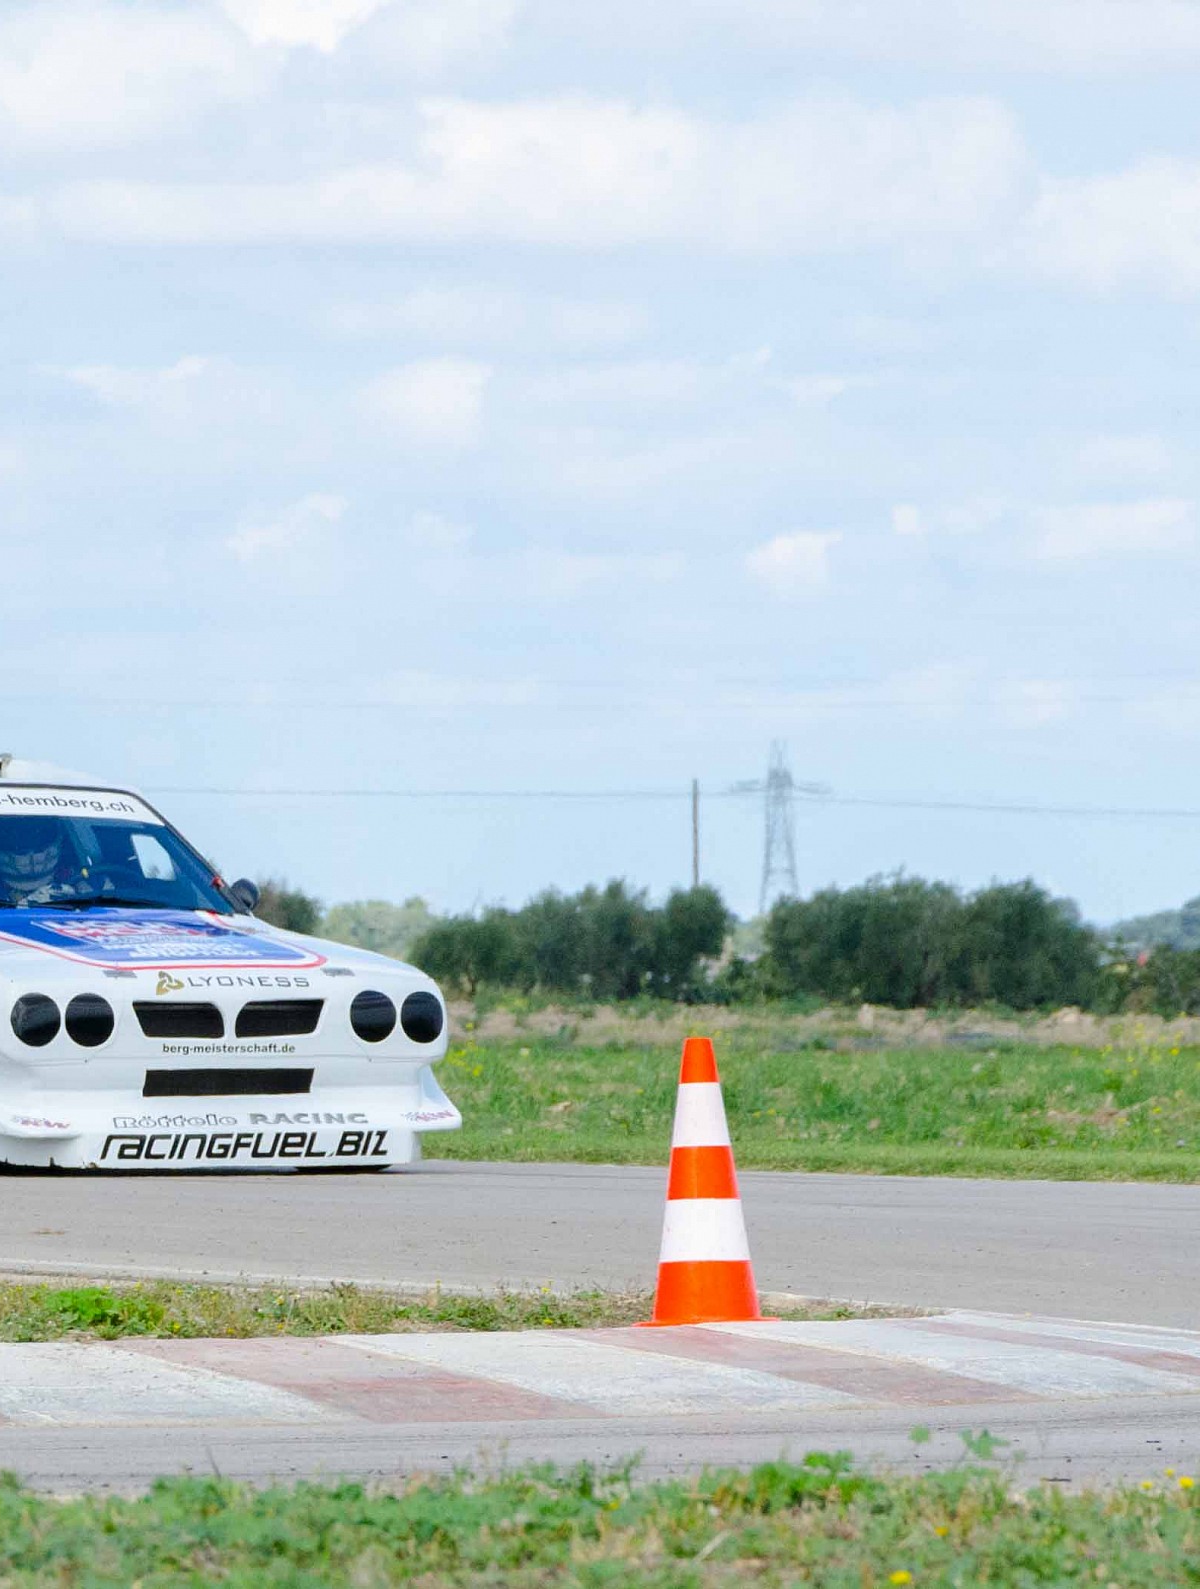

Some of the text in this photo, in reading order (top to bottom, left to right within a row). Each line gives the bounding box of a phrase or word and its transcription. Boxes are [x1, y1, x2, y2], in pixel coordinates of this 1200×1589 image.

[186, 975, 311, 988] LYONESS
[162, 1042, 296, 1055] berg-meisterschaft.de
[249, 1112, 369, 1125] RACING
